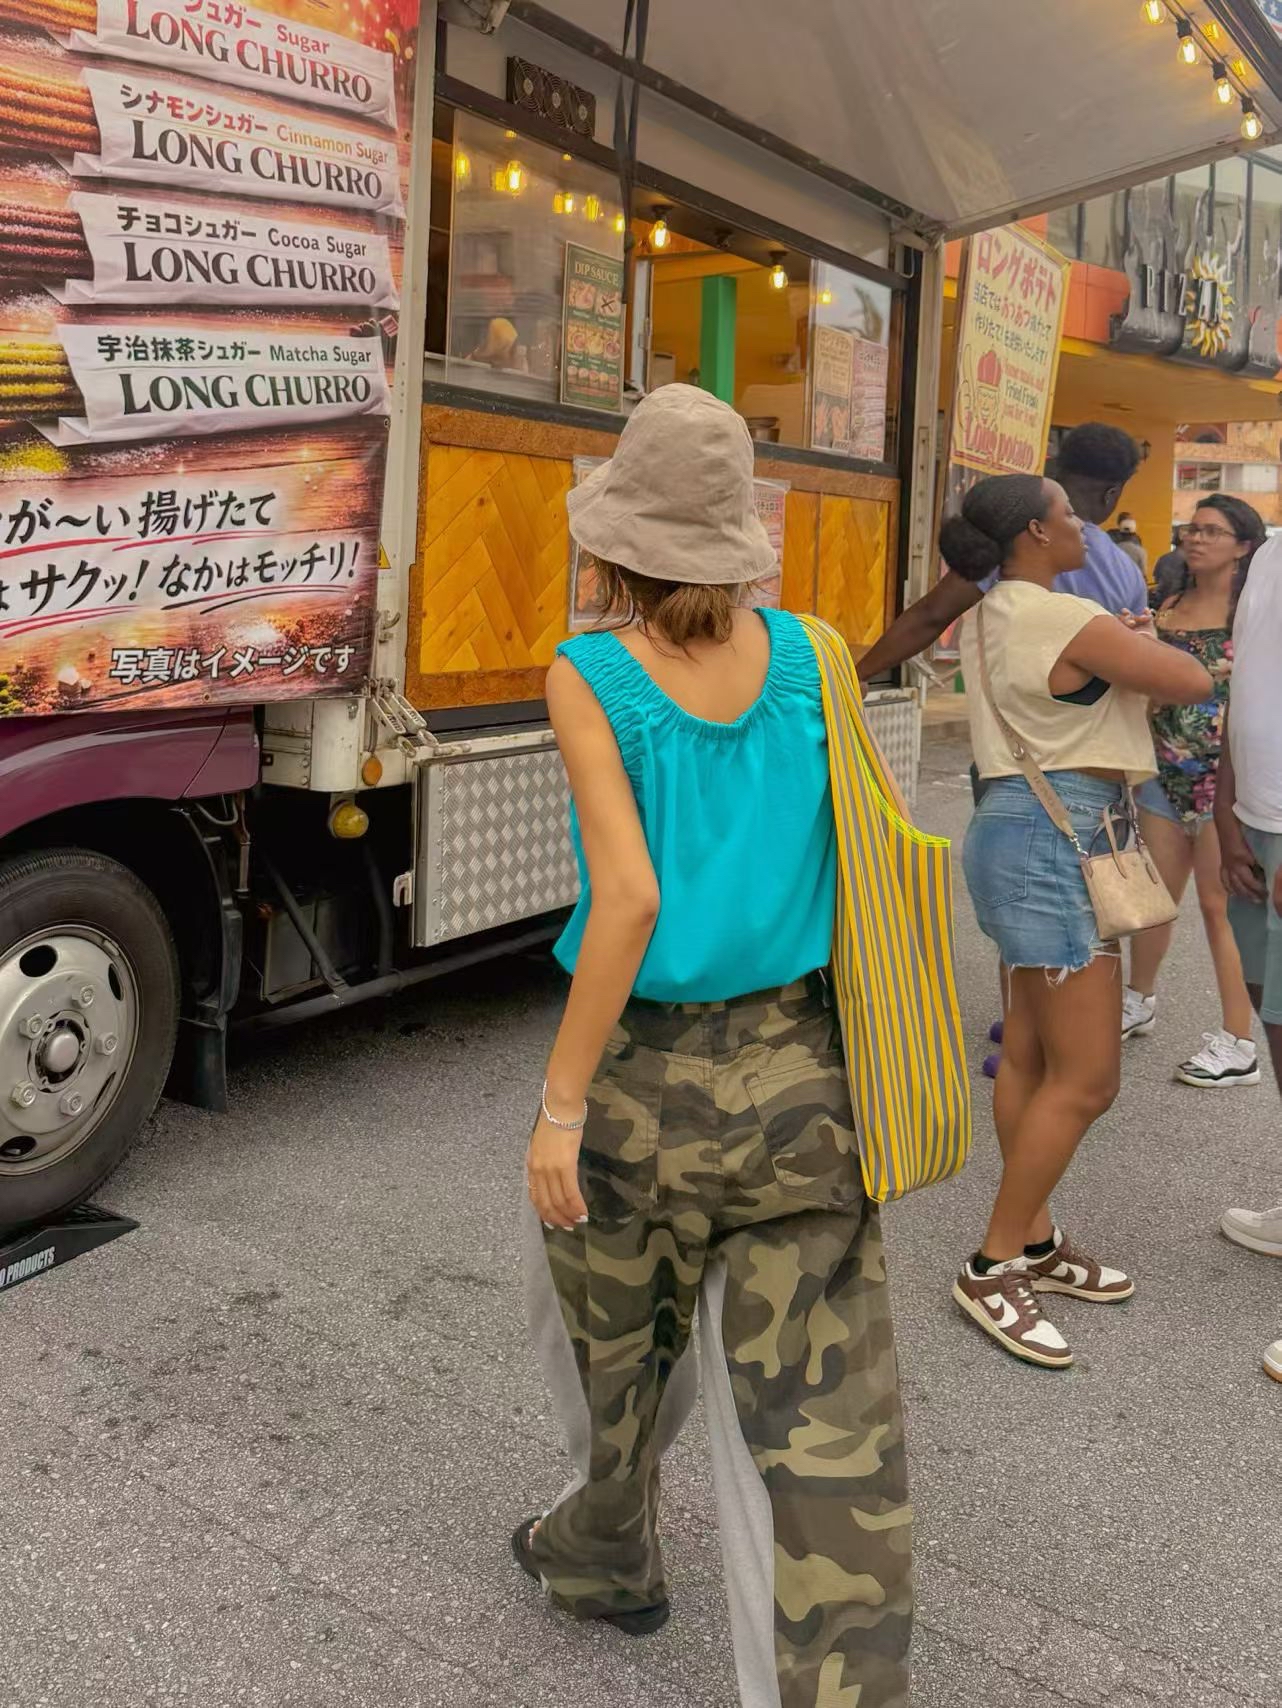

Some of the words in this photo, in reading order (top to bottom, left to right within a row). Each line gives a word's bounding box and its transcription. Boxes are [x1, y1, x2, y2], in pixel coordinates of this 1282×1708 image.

[126, 0, 229, 63] LONG
[236, 38, 373, 103] CHURRO
[277, 24, 330, 55] Sugar
[119, 84, 268, 134] シナモンシュガー
[131, 119, 243, 175] LONG
[250, 147, 382, 200] CHURRO
[277, 123, 353, 156] Cinnamon
[356, 142, 389, 165] Sugar
[117, 205, 256, 241] チョコシュガー
[268, 227, 320, 251] Cocoa
[327, 236, 367, 259] Sugar
[123, 241, 239, 285] LONG
[246, 254, 376, 295] CHURRO
[590, 265, 619, 286] SAUCE
[97, 335, 261, 363] 宇治抹茶シュガー
[270, 345, 329, 363] Matcha
[333, 346, 371, 365] Sugar
[118, 373, 238, 415] LONG
[244, 373, 371, 407] CHURRO
[109, 645, 356, 685] 写真はイメージです
[6, 1247, 55, 1284] PRODUCTS
